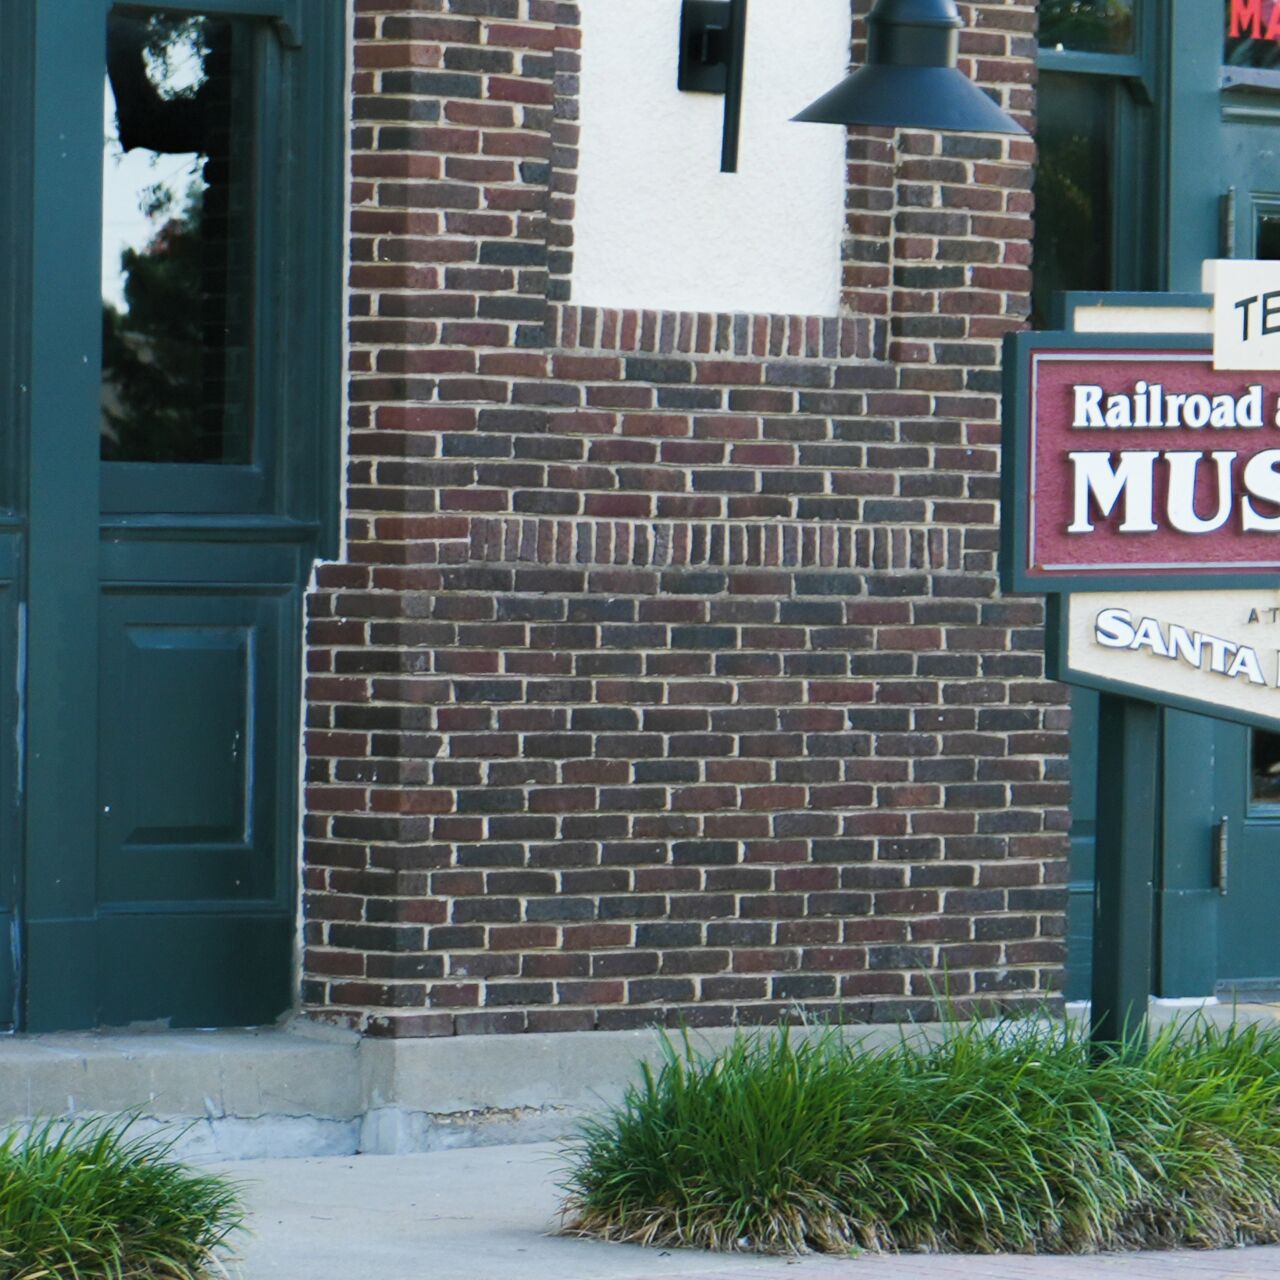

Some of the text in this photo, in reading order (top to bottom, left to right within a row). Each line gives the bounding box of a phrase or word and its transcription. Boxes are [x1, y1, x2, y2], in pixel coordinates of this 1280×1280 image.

[1071, 381, 1264, 430] Railroad
[1247, 607, 1279, 624] AT
[1095, 607, 1266, 686] SANTA
